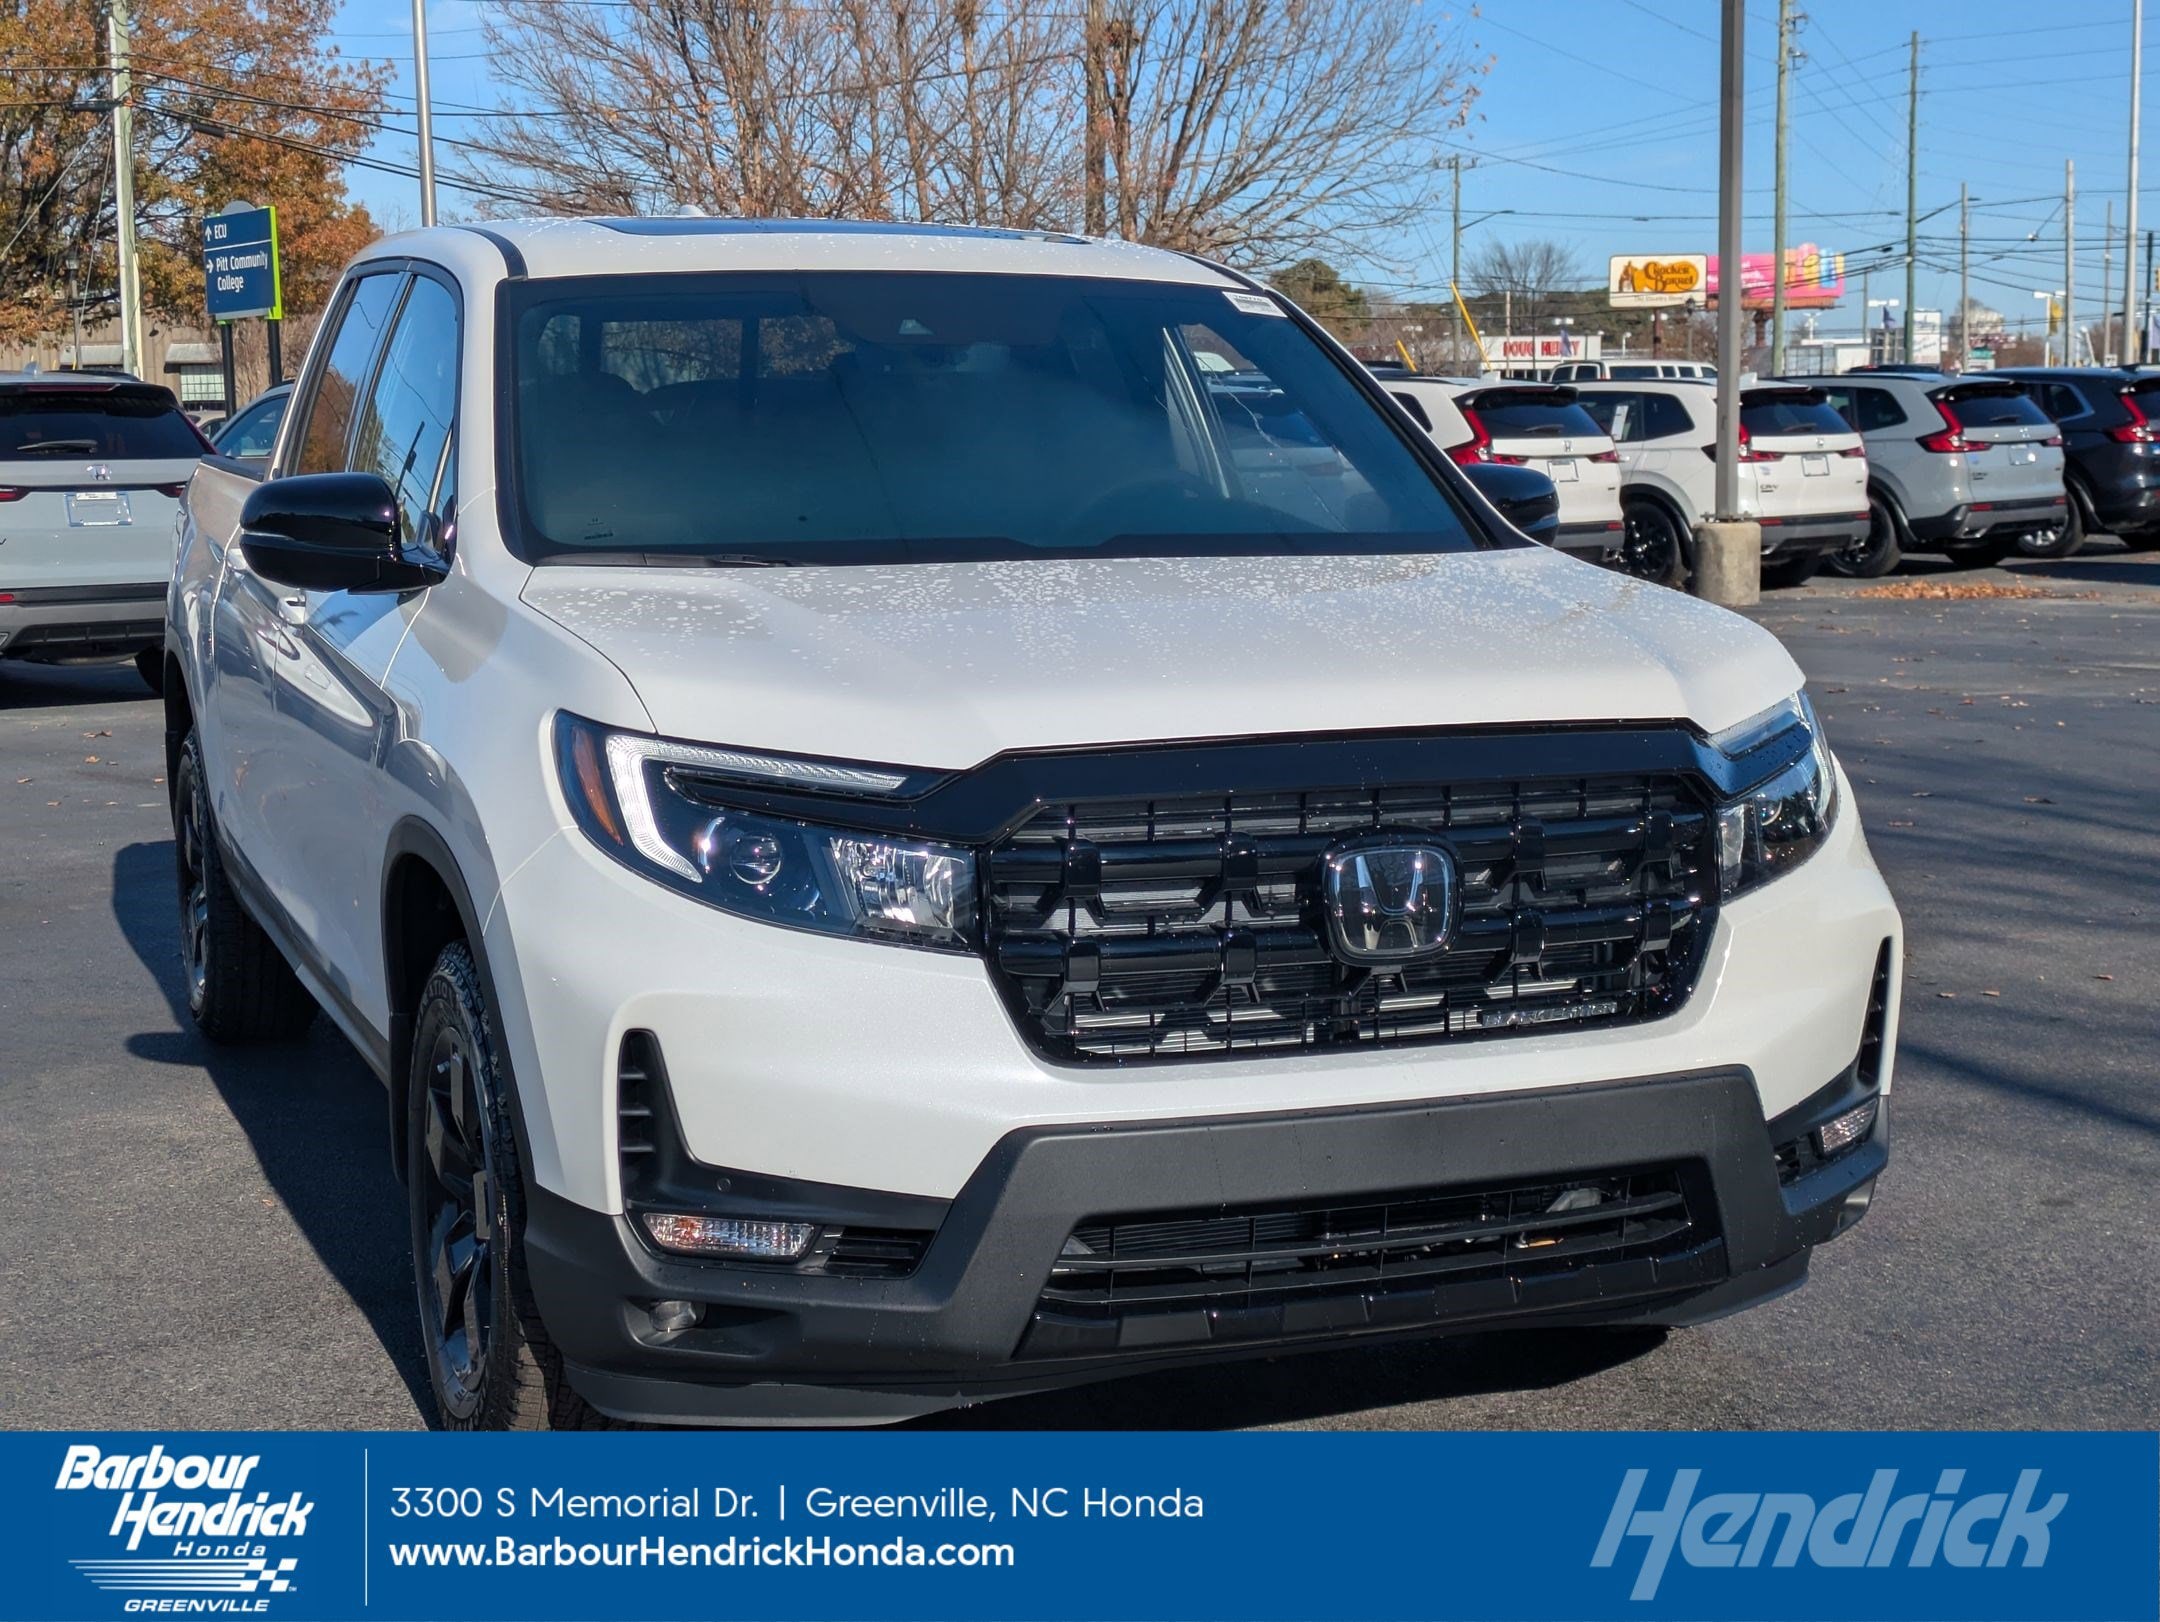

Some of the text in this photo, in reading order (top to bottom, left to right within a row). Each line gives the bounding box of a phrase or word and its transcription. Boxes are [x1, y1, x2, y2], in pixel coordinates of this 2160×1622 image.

[214, 223, 227, 239] ECU
[216, 251, 268, 272] Pitt Community
[217, 275, 244, 293] College
